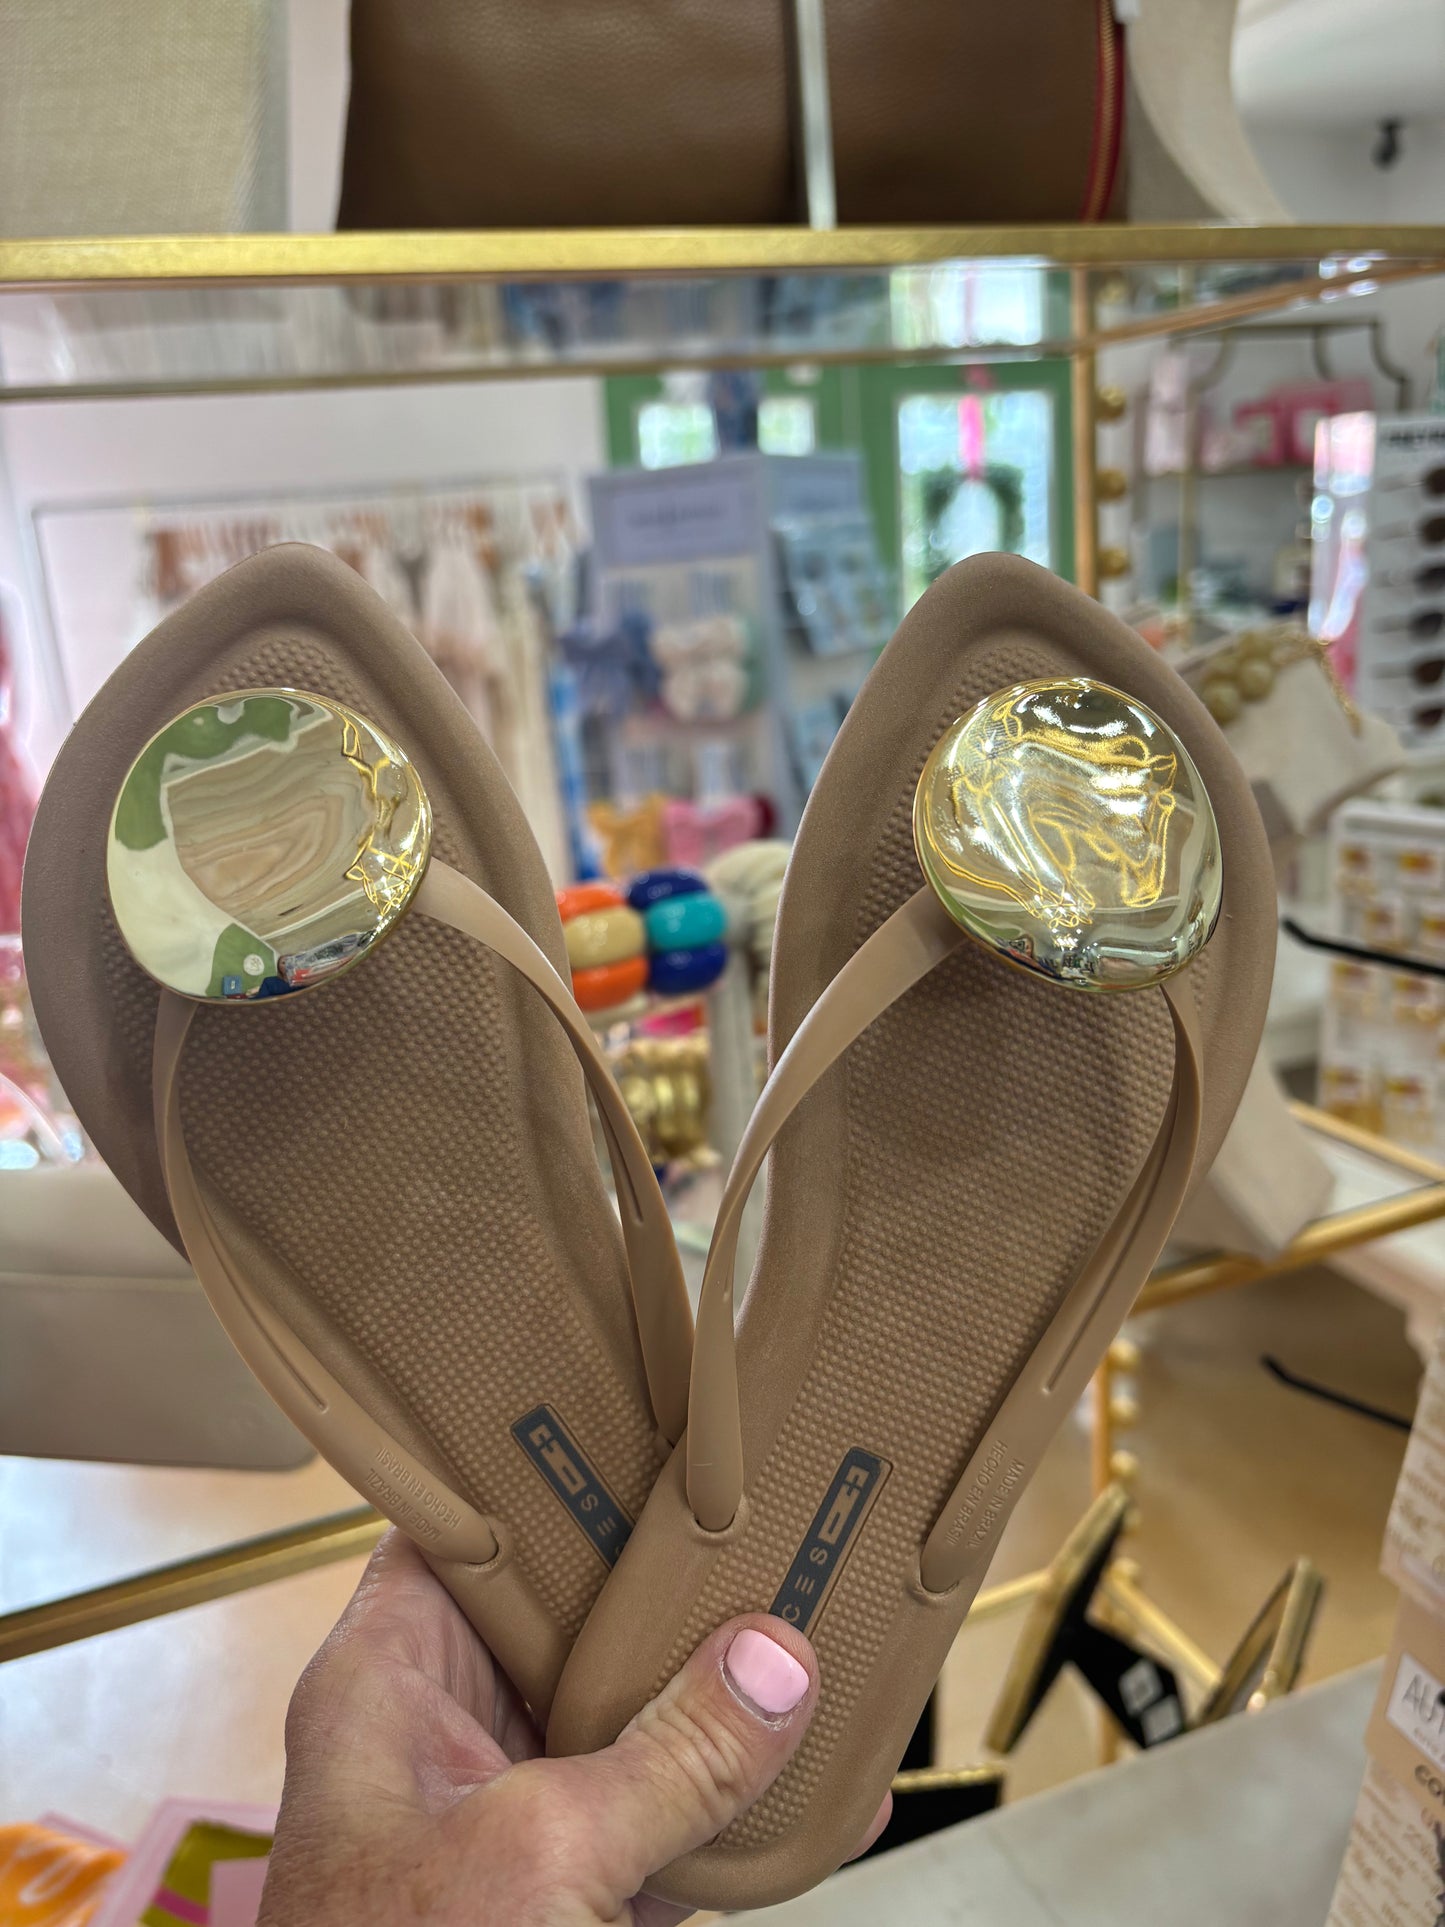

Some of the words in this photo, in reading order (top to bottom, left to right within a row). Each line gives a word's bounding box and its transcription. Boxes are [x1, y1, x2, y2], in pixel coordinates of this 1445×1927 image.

[976, 1440, 1008, 1488] HECHO
[997, 1458, 1025, 1496] MADE
[366, 1468, 402, 1507] BRAZIL
[966, 1485, 984, 1510] EN
[991, 1494, 1004, 1511] IN
[397, 1501, 413, 1518] IN
[410, 1511, 442, 1541] MADE
[967, 1509, 997, 1548] BRAZIL
